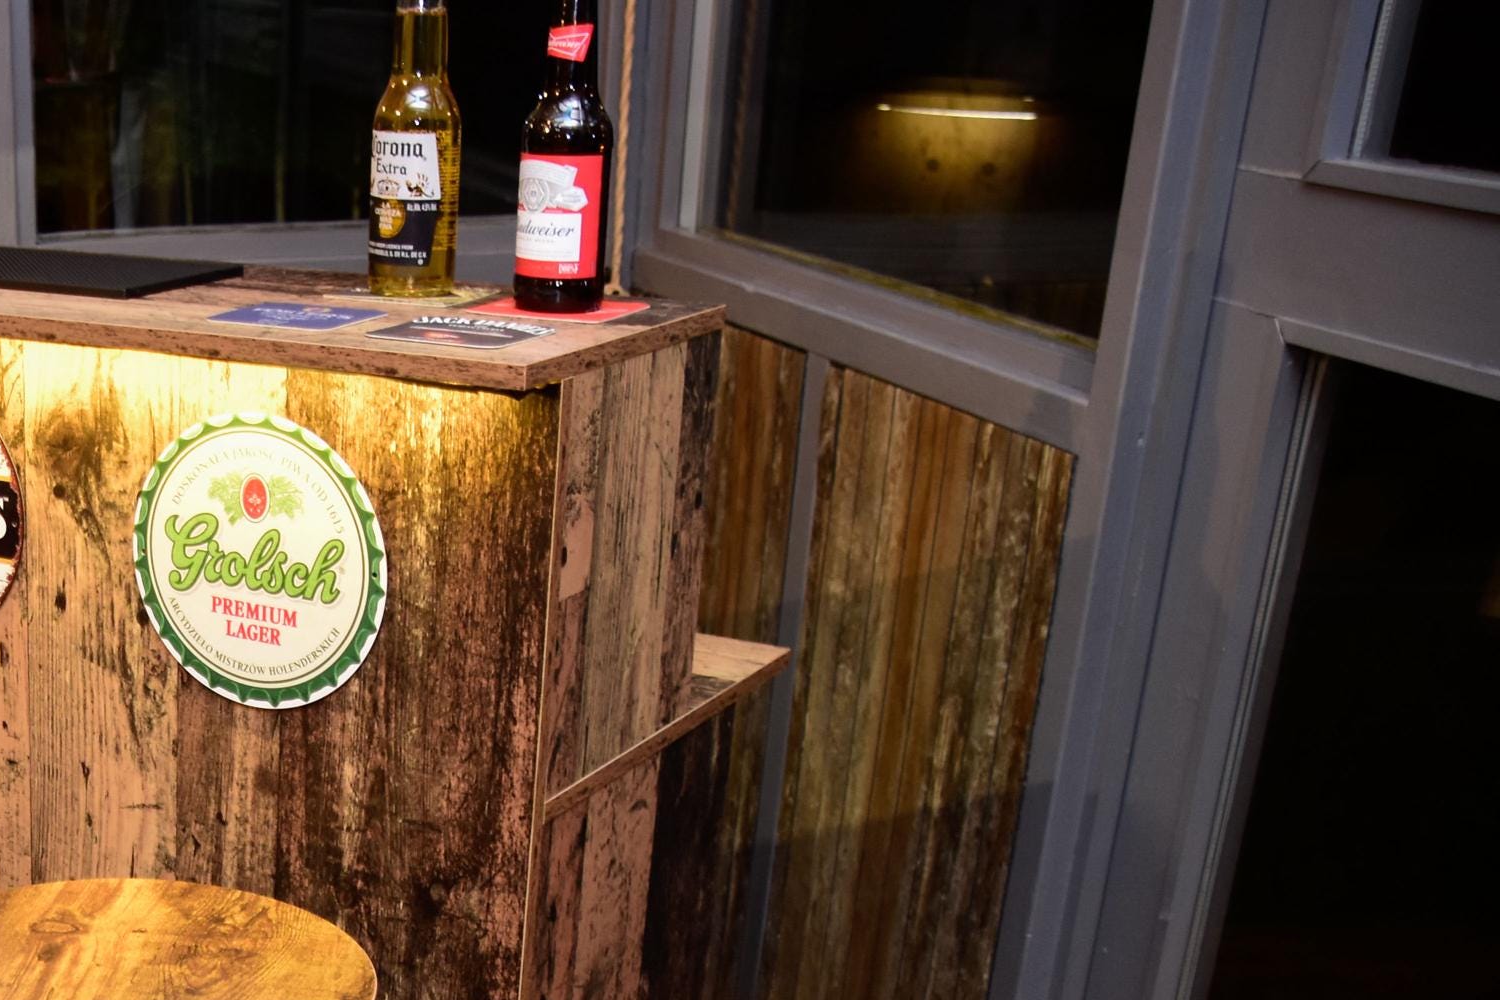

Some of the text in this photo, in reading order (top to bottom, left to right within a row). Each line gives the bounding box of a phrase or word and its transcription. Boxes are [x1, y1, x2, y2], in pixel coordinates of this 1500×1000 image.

[376, 157, 407, 175] Extra
[164, 512, 345, 605] Grolsch
[211, 595, 298, 628] PREMIUM
[226, 619, 281, 647] LAGER
